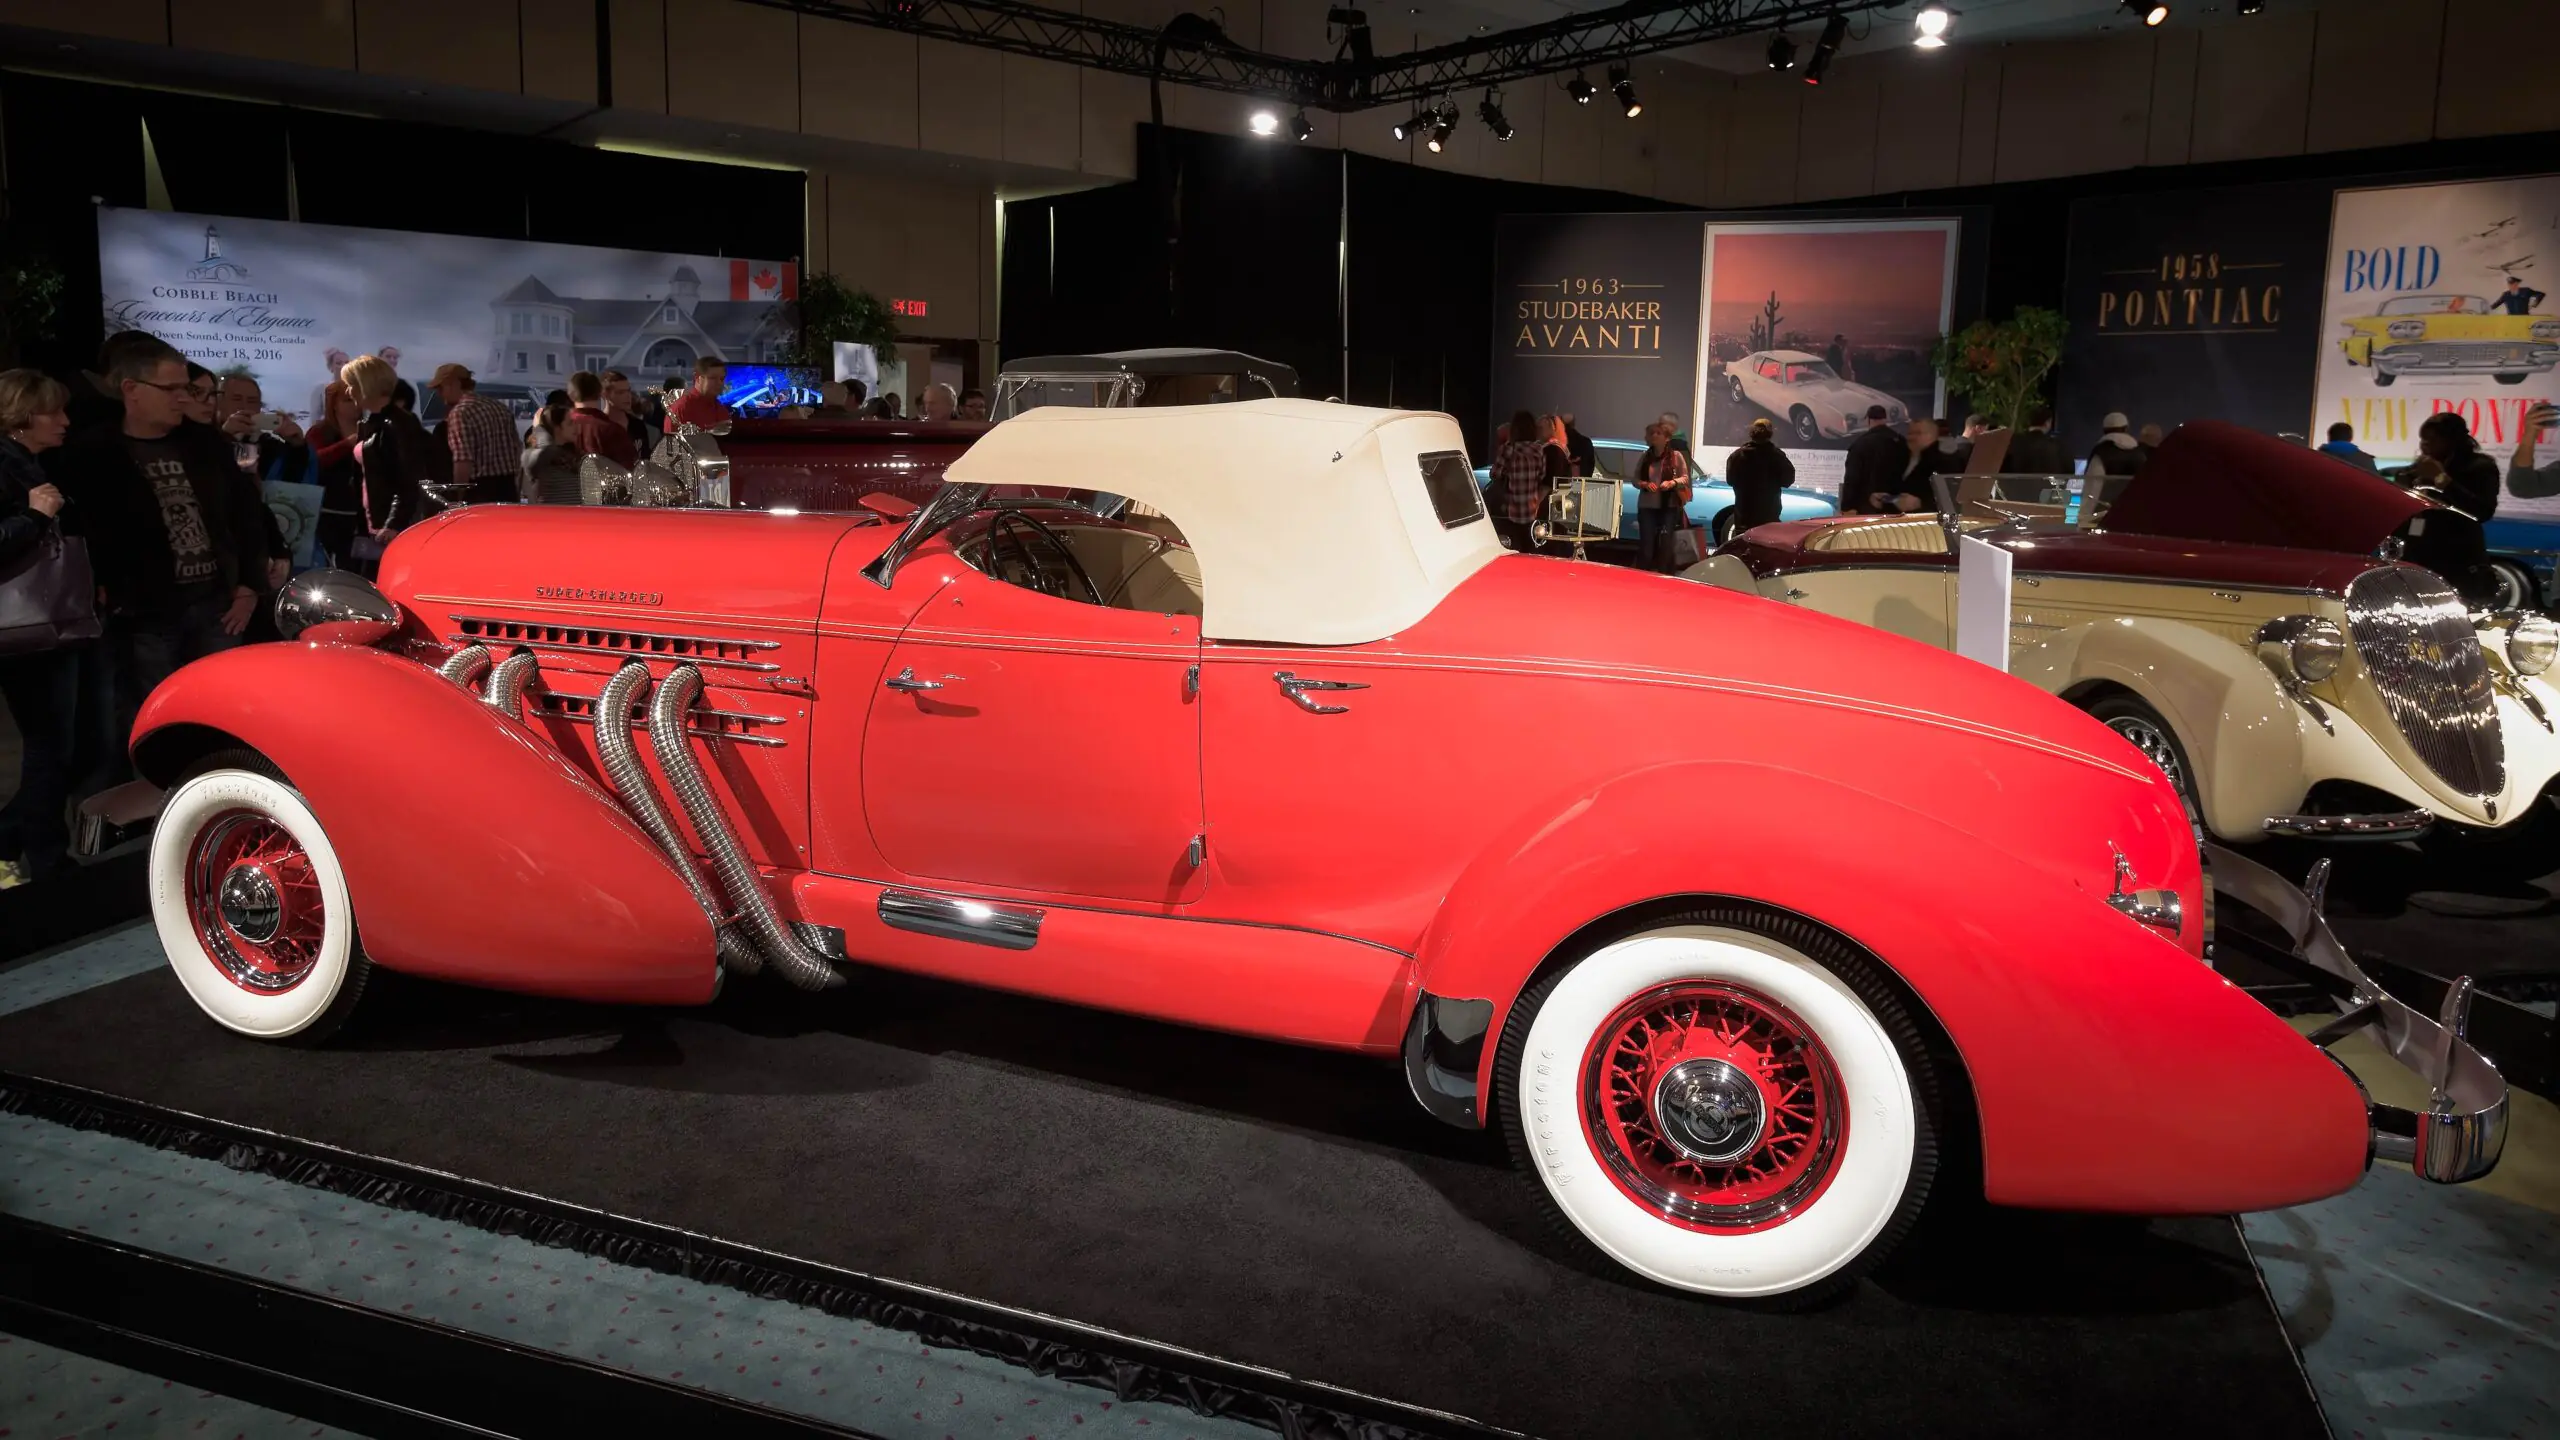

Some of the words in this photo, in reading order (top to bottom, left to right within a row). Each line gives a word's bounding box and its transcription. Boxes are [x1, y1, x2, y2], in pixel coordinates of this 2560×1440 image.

[2161, 252, 2220, 281] 1958
[2344, 245, 2440, 293] BOLD
[152, 286, 219, 301] COBBLE
[225, 290, 278, 304] BEACH
[1561, 278, 1619, 295] 1963
[112, 299, 208, 324] Concours
[908, 300, 927, 316] EXIT
[1518, 301, 1661, 320] STUDEBAKER
[2098, 285, 2281, 327] PONTIAC
[152, 329, 183, 340] Owen
[186, 331, 222, 343] Sound,
[224, 333, 267, 344] Ontario,
[269, 335, 306, 345] Canada
[1515, 323, 1660, 349] AVANTI
[177, 348, 229, 359] tember
[233, 348, 250, 361] 18,
[254, 349, 283, 360] 2016
